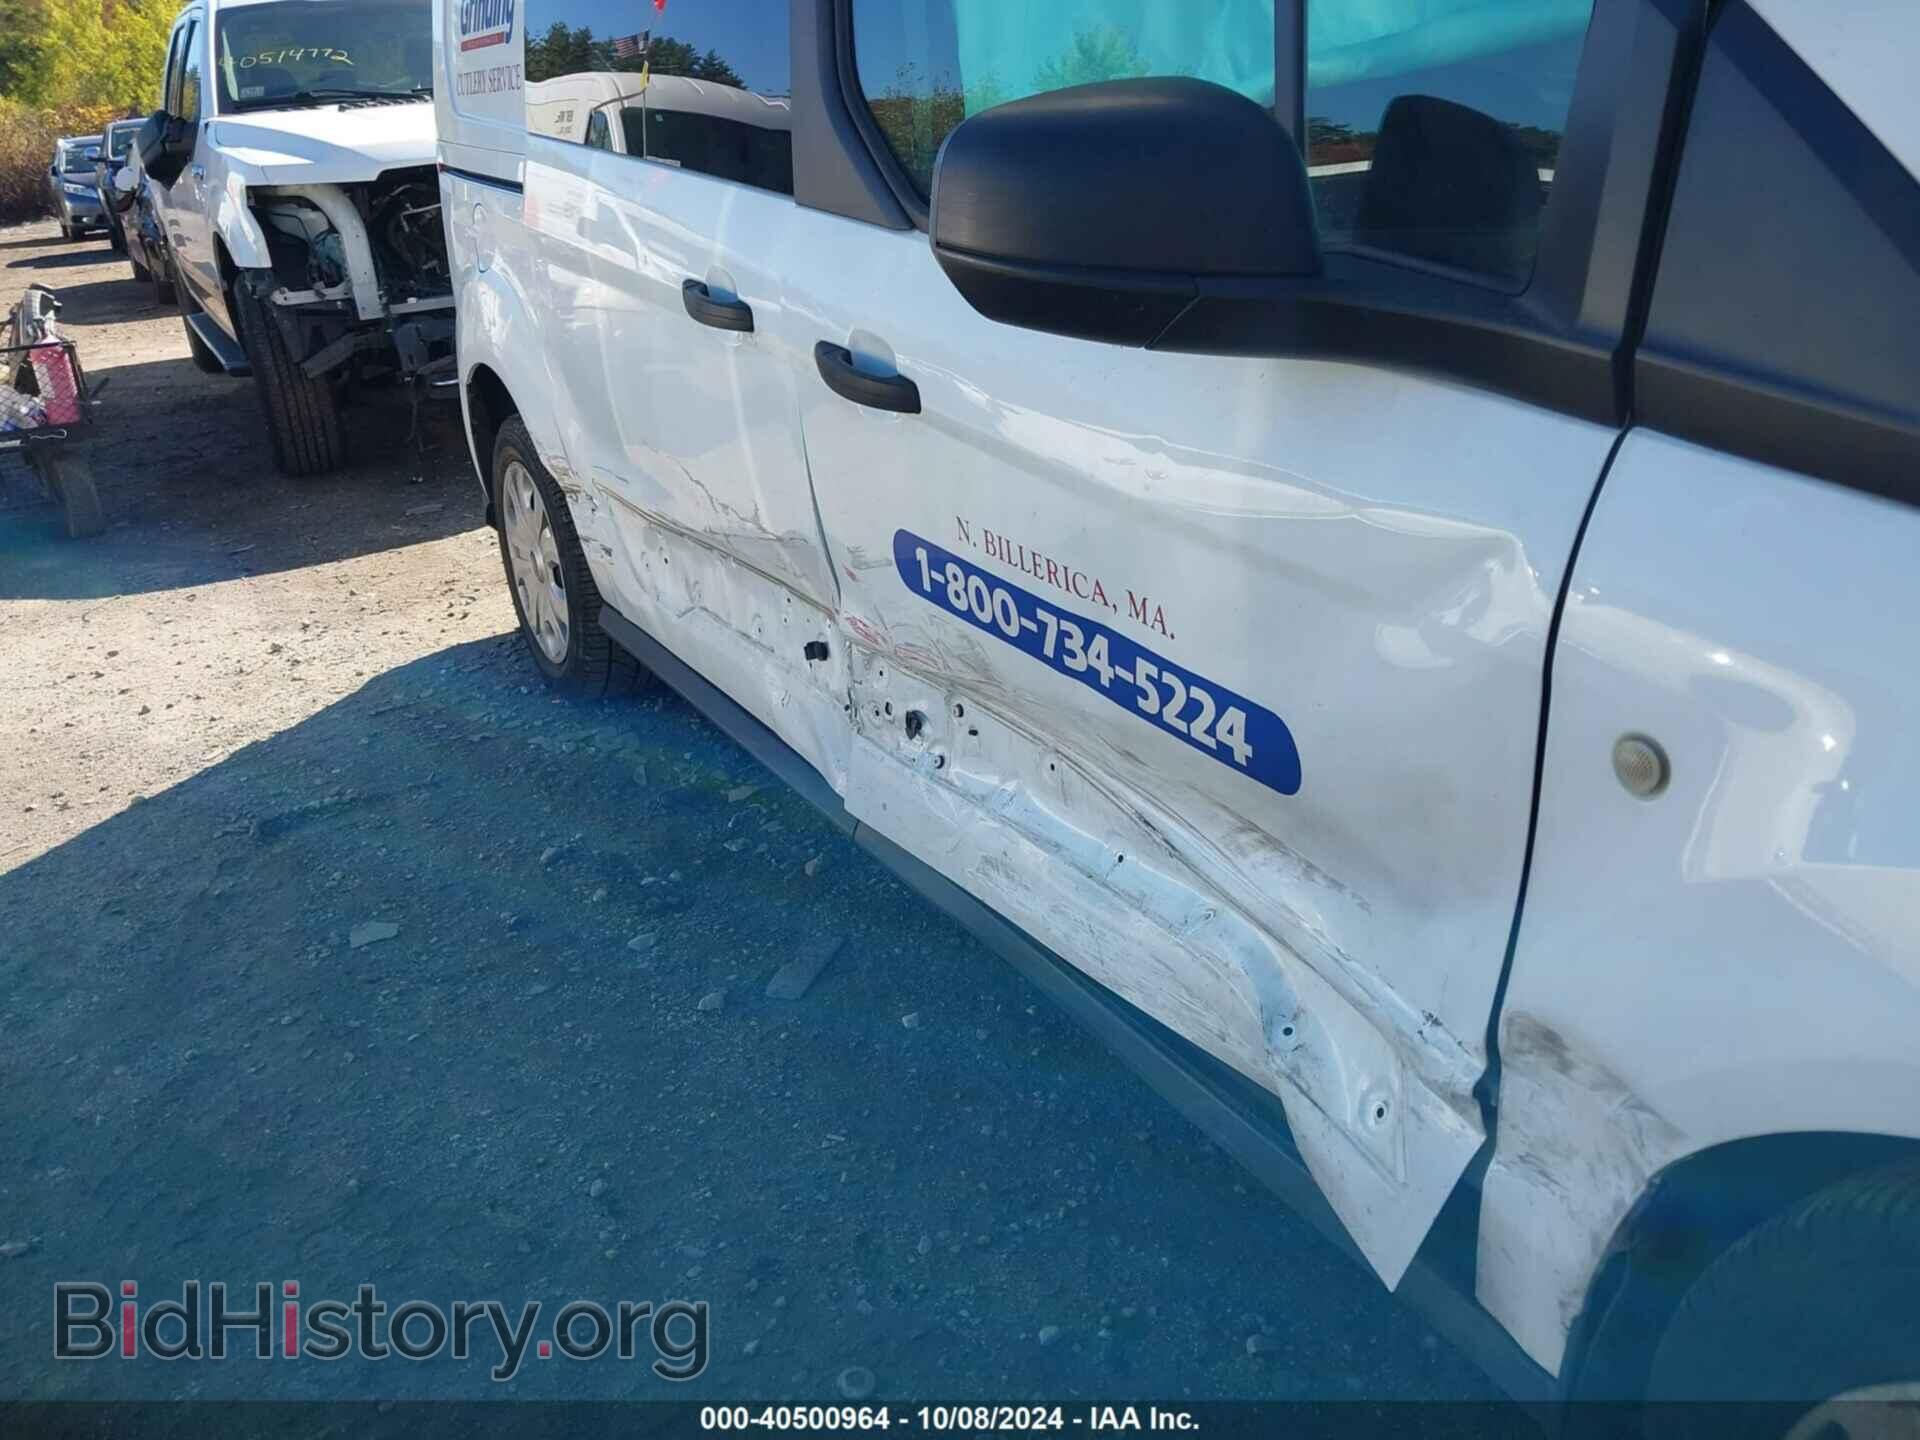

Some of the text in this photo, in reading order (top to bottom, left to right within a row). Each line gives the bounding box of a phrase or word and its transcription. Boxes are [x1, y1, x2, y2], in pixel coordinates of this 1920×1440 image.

[457, 63, 521, 96] CUTLERY SERVICE
[956, 515, 1176, 641] N. BILLERICA, MA.
[915, 546, 1254, 767] 1-800-734-5224
